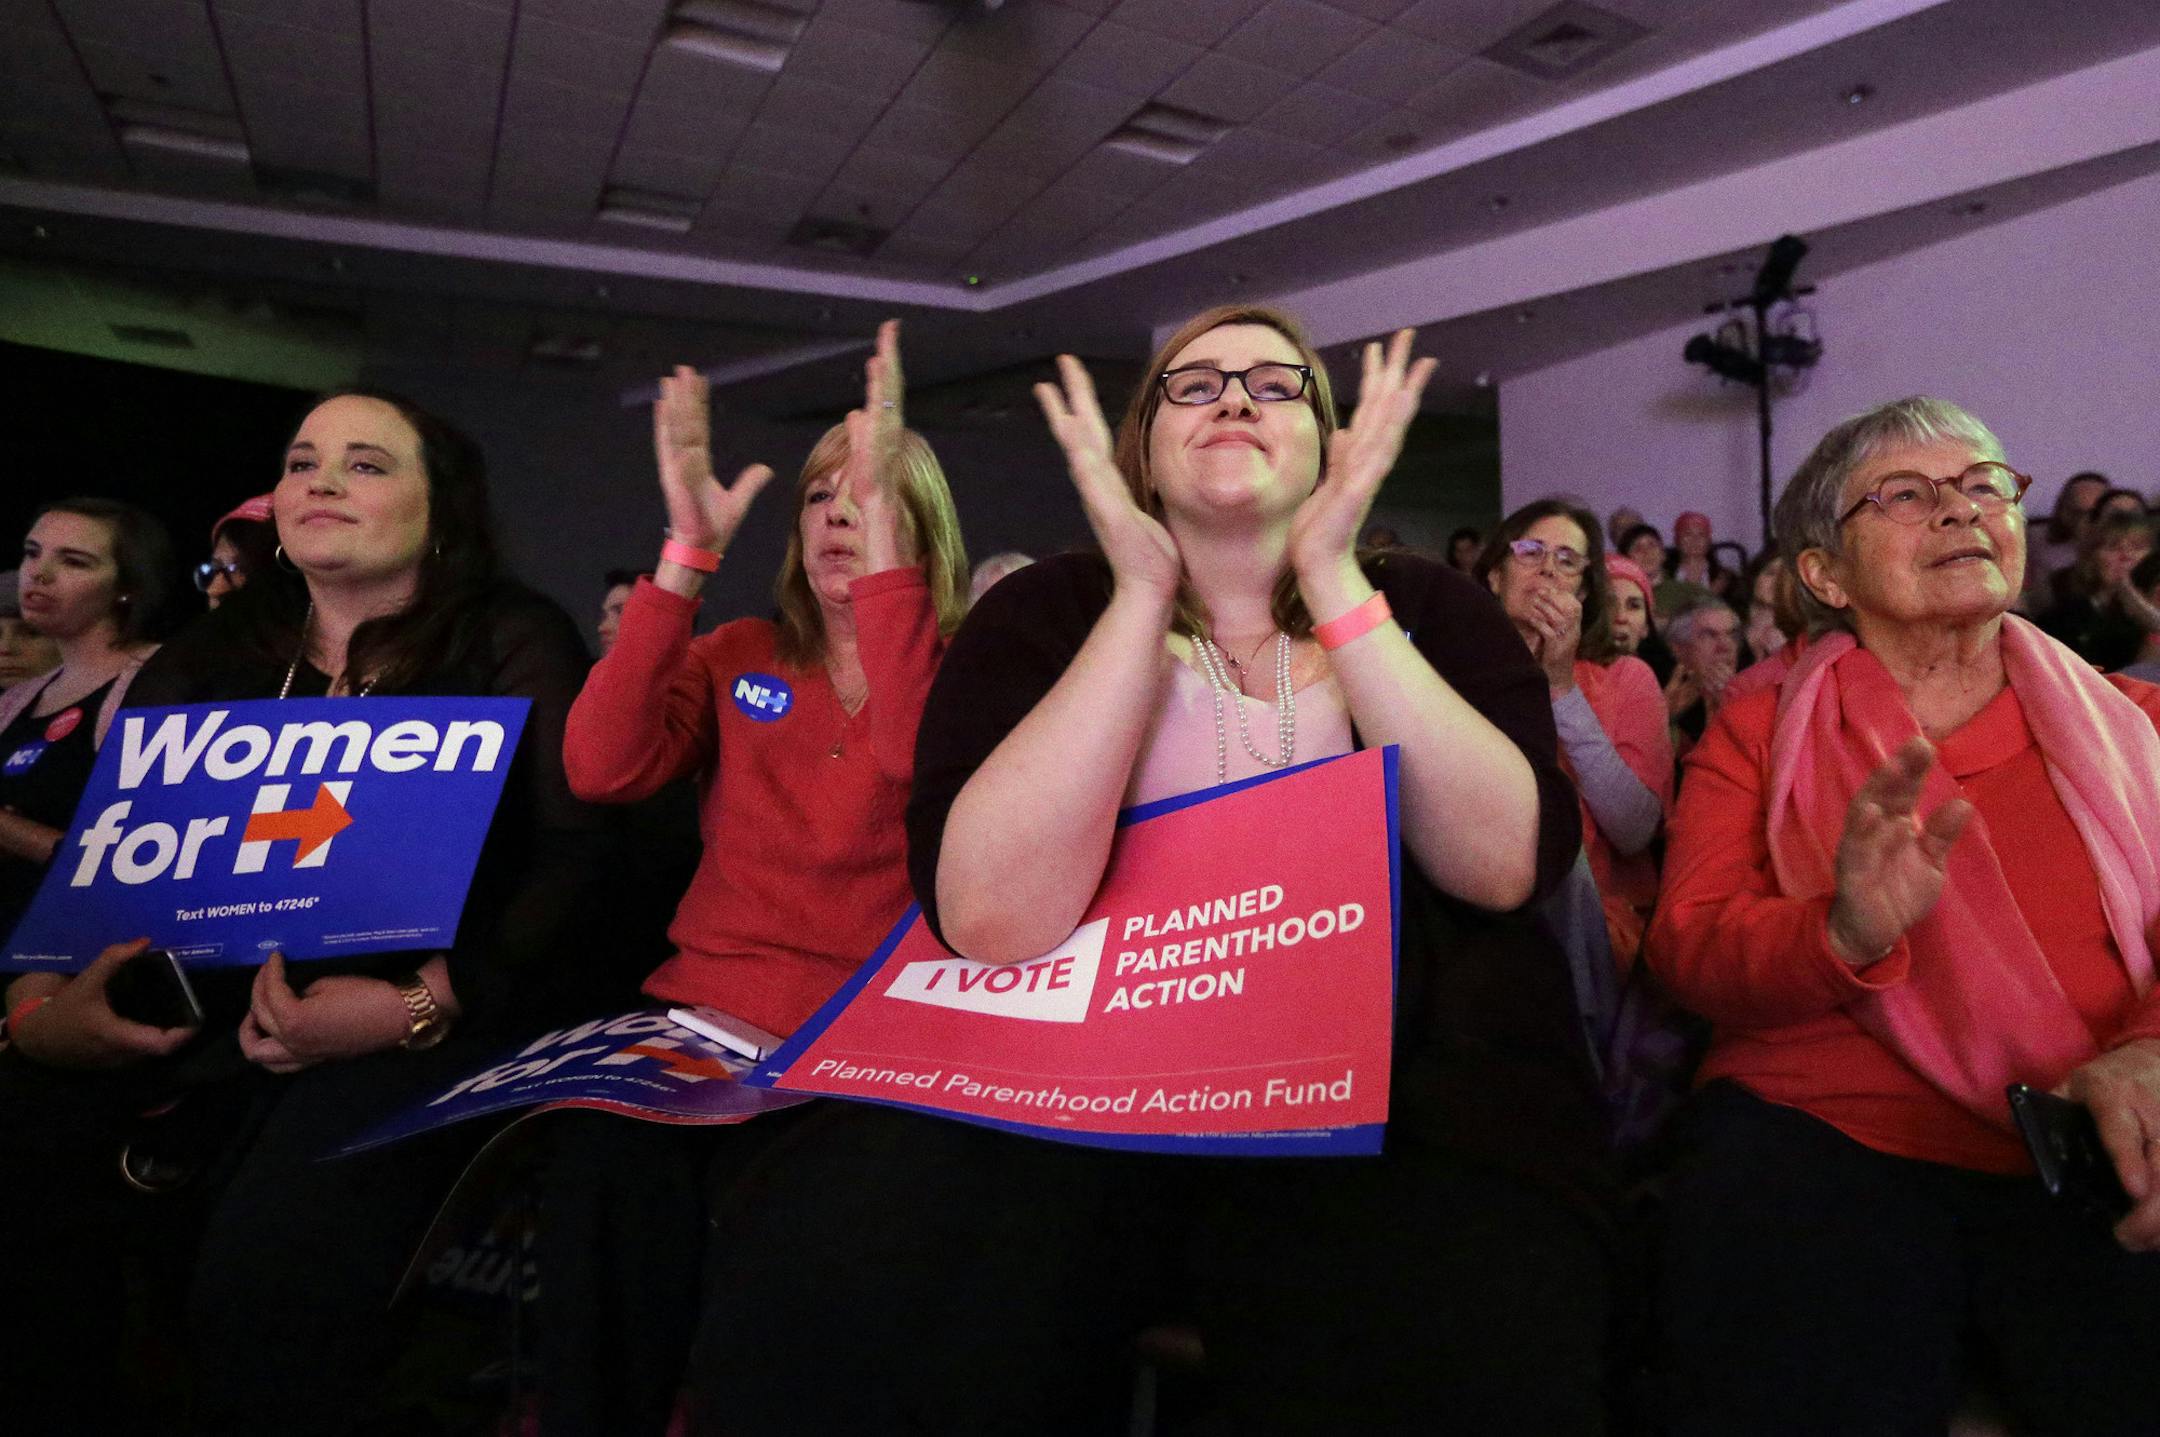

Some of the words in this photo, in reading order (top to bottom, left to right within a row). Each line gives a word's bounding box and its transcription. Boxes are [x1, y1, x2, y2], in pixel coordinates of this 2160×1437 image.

[118, 710, 505, 789] Women
[70, 800, 229, 888] for
[232, 780, 354, 875] H
[176, 909, 204, 921] Text
[206, 903, 256, 918] WOMEN
[258, 901, 273, 912] to
[1115, 902, 1366, 977] PARENTHOOD
[1122, 884, 1284, 941] PLANNED
[924, 967, 945, 992] I
[957, 956, 1076, 994] VOTE
[1104, 968, 1246, 1014] ACTION
[425, 1045, 611, 1108] for
[811, 1059, 942, 1089] Planned
[943, 1073, 1138, 1114] Parenthood
[1140, 1085, 1252, 1114] Action
[1264, 1069, 1353, 1108] Fund
